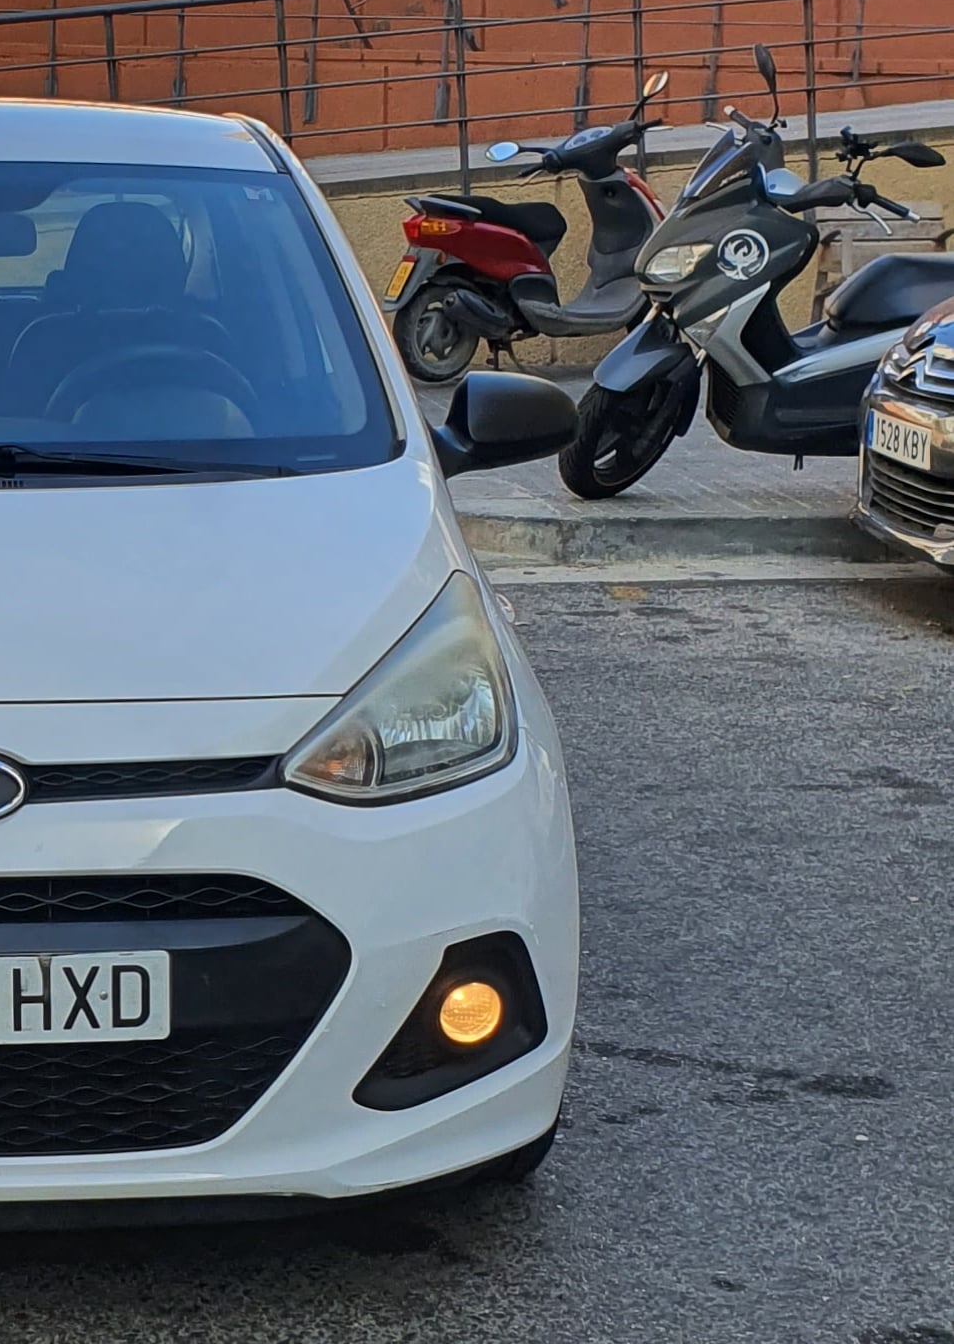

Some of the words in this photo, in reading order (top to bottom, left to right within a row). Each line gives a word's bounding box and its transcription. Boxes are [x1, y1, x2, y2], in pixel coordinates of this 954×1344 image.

[875, 417, 900, 453] 1528
[903, 428, 928, 463] KBY
[12, 965, 151, 1032] HXD
